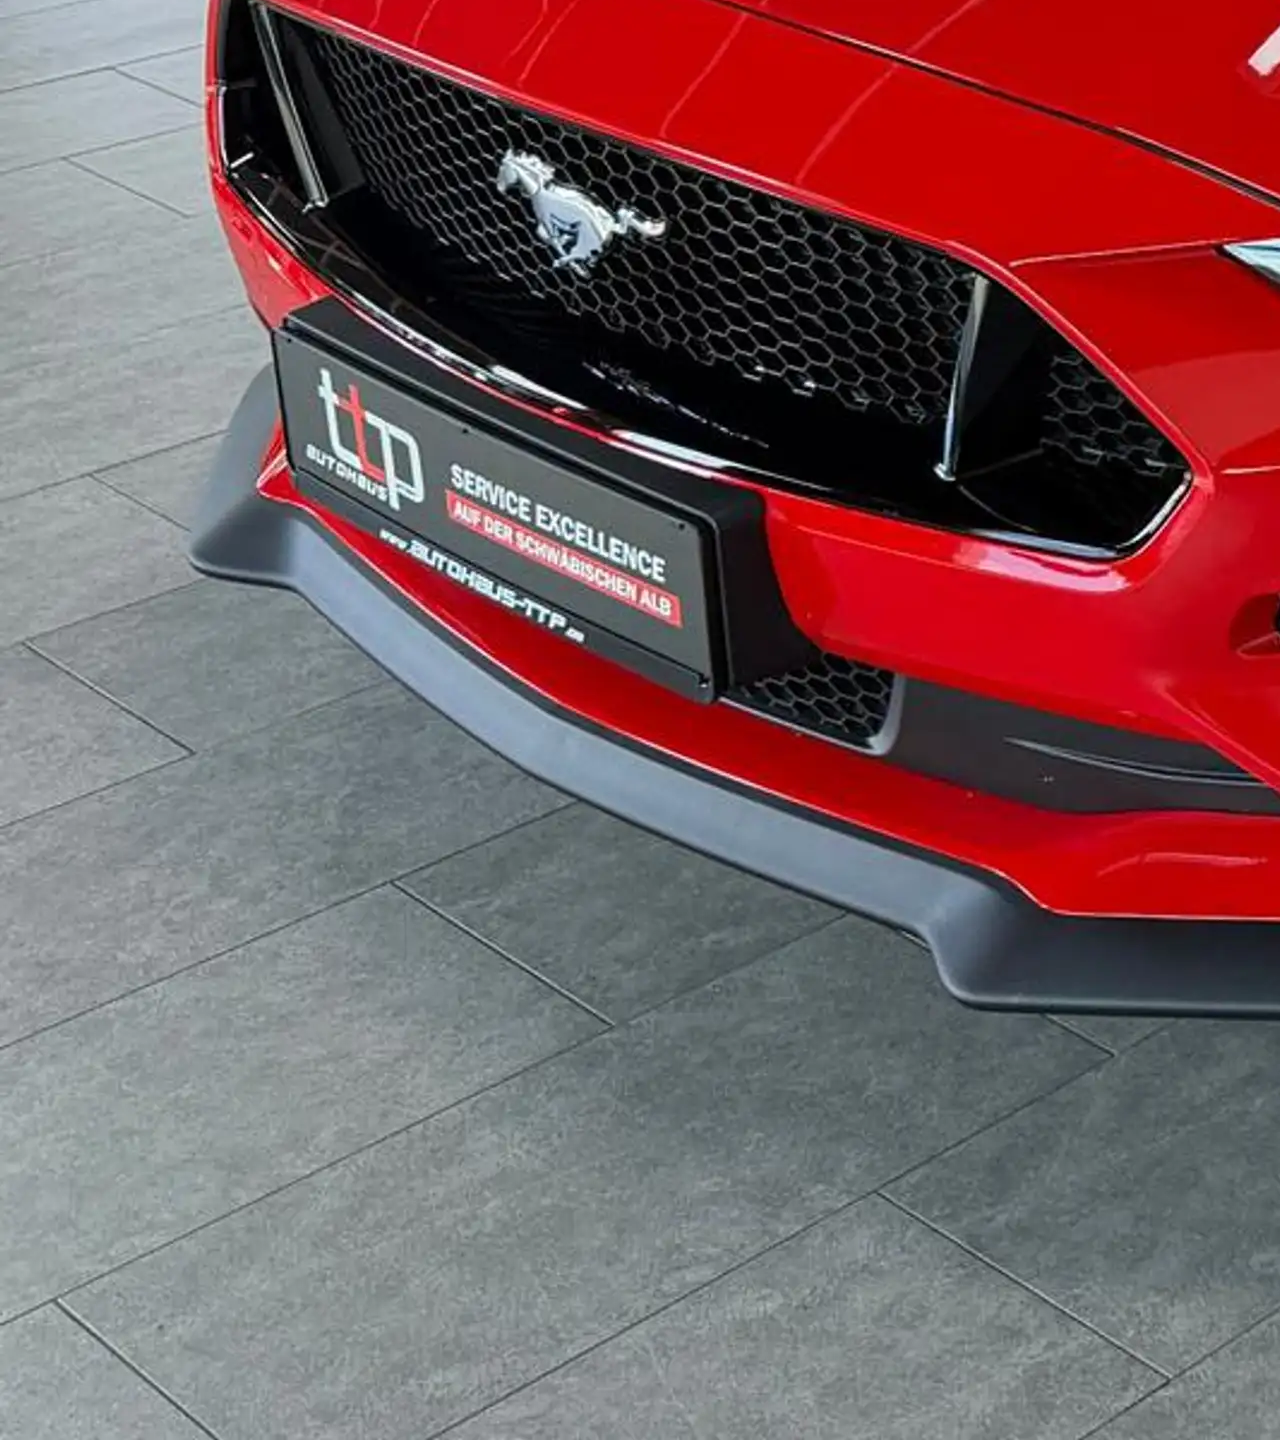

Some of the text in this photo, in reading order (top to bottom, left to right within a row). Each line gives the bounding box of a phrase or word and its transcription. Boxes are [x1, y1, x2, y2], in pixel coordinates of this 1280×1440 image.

[317, 367, 424, 511] ttp
[450, 463, 667, 583] SERVICE EXCELLENCE
[454, 500, 482, 527] AUF
[484, 515, 513, 544] DER
[640, 587, 673, 617] ALB
